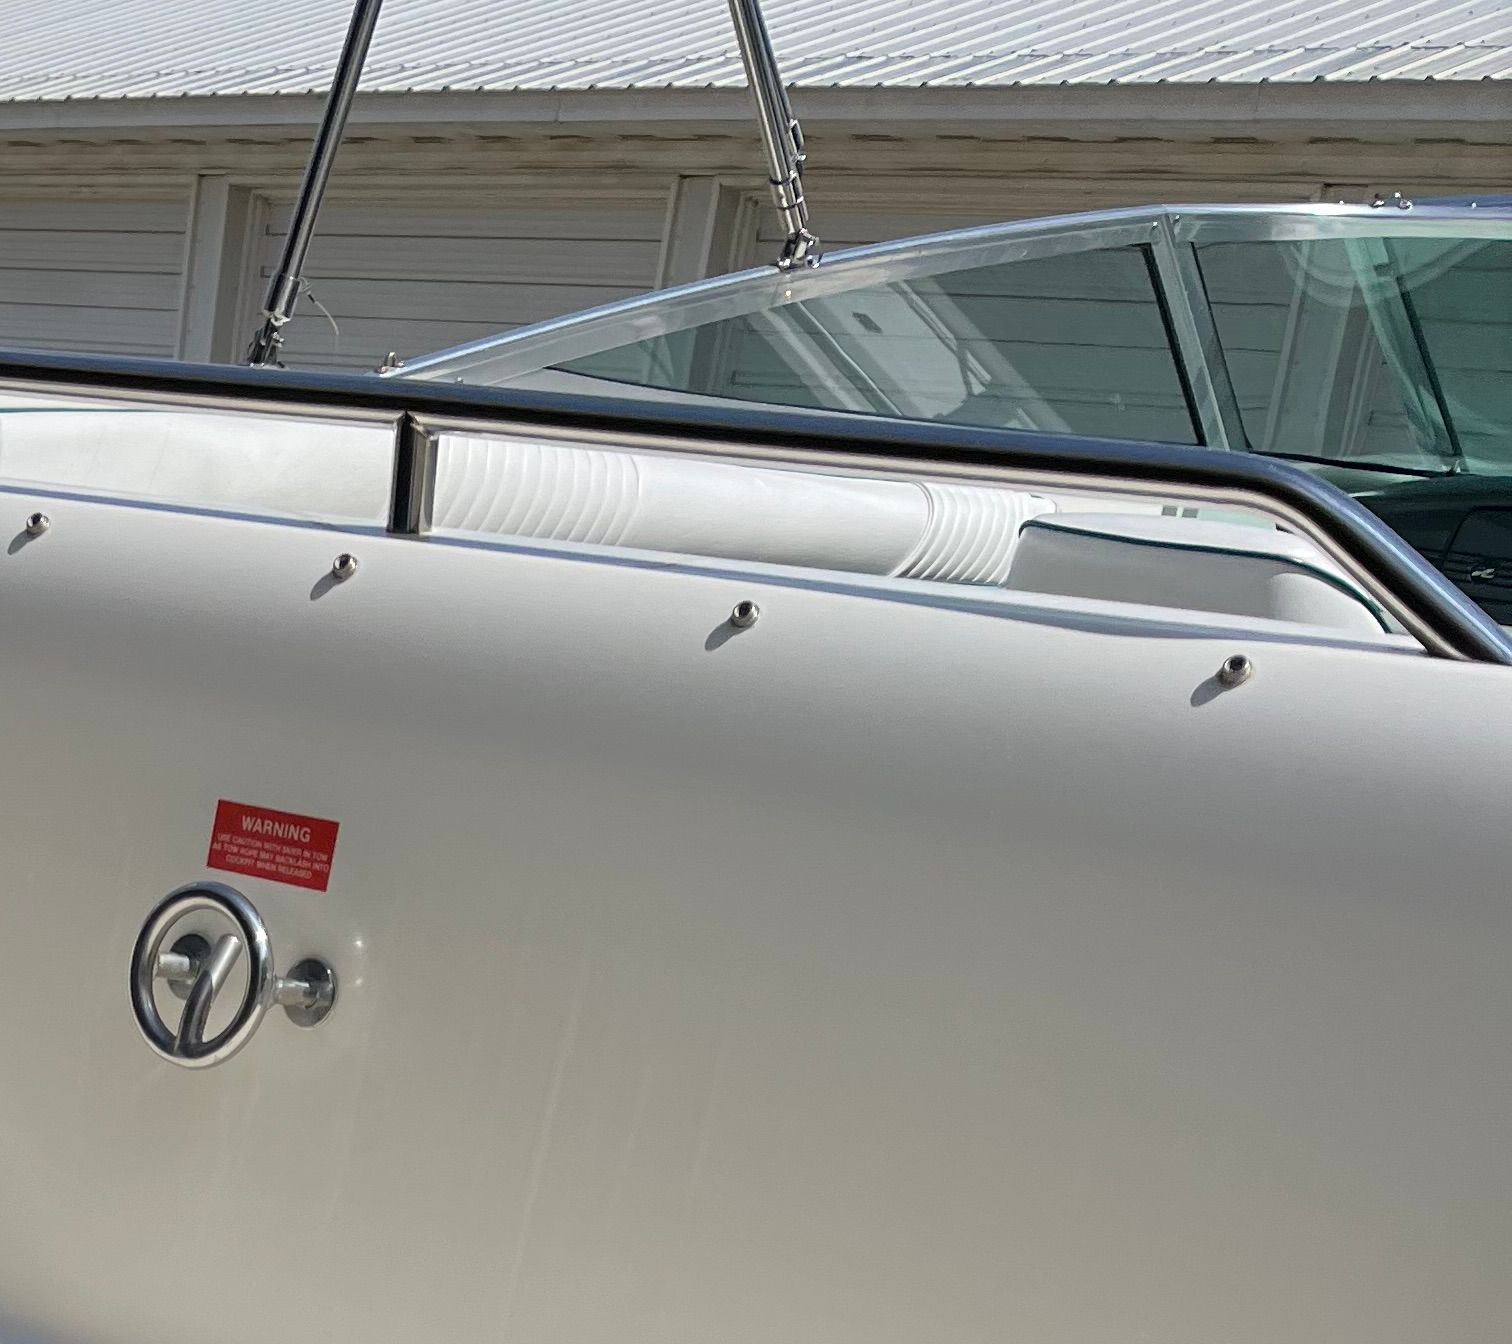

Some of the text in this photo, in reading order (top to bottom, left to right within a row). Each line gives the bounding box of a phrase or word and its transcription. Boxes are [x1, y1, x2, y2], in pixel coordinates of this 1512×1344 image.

[242, 815, 312, 843] WARNING
[223, 843, 239, 854] TOW
[275, 853, 311, 868] BACKLASH
[312, 860, 329, 872] INTO
[232, 835, 263, 848] CAUTION
[263, 842, 281, 852] WITH
[312, 851, 329, 861] TOW
[278, 864, 312, 879] RELEASED
